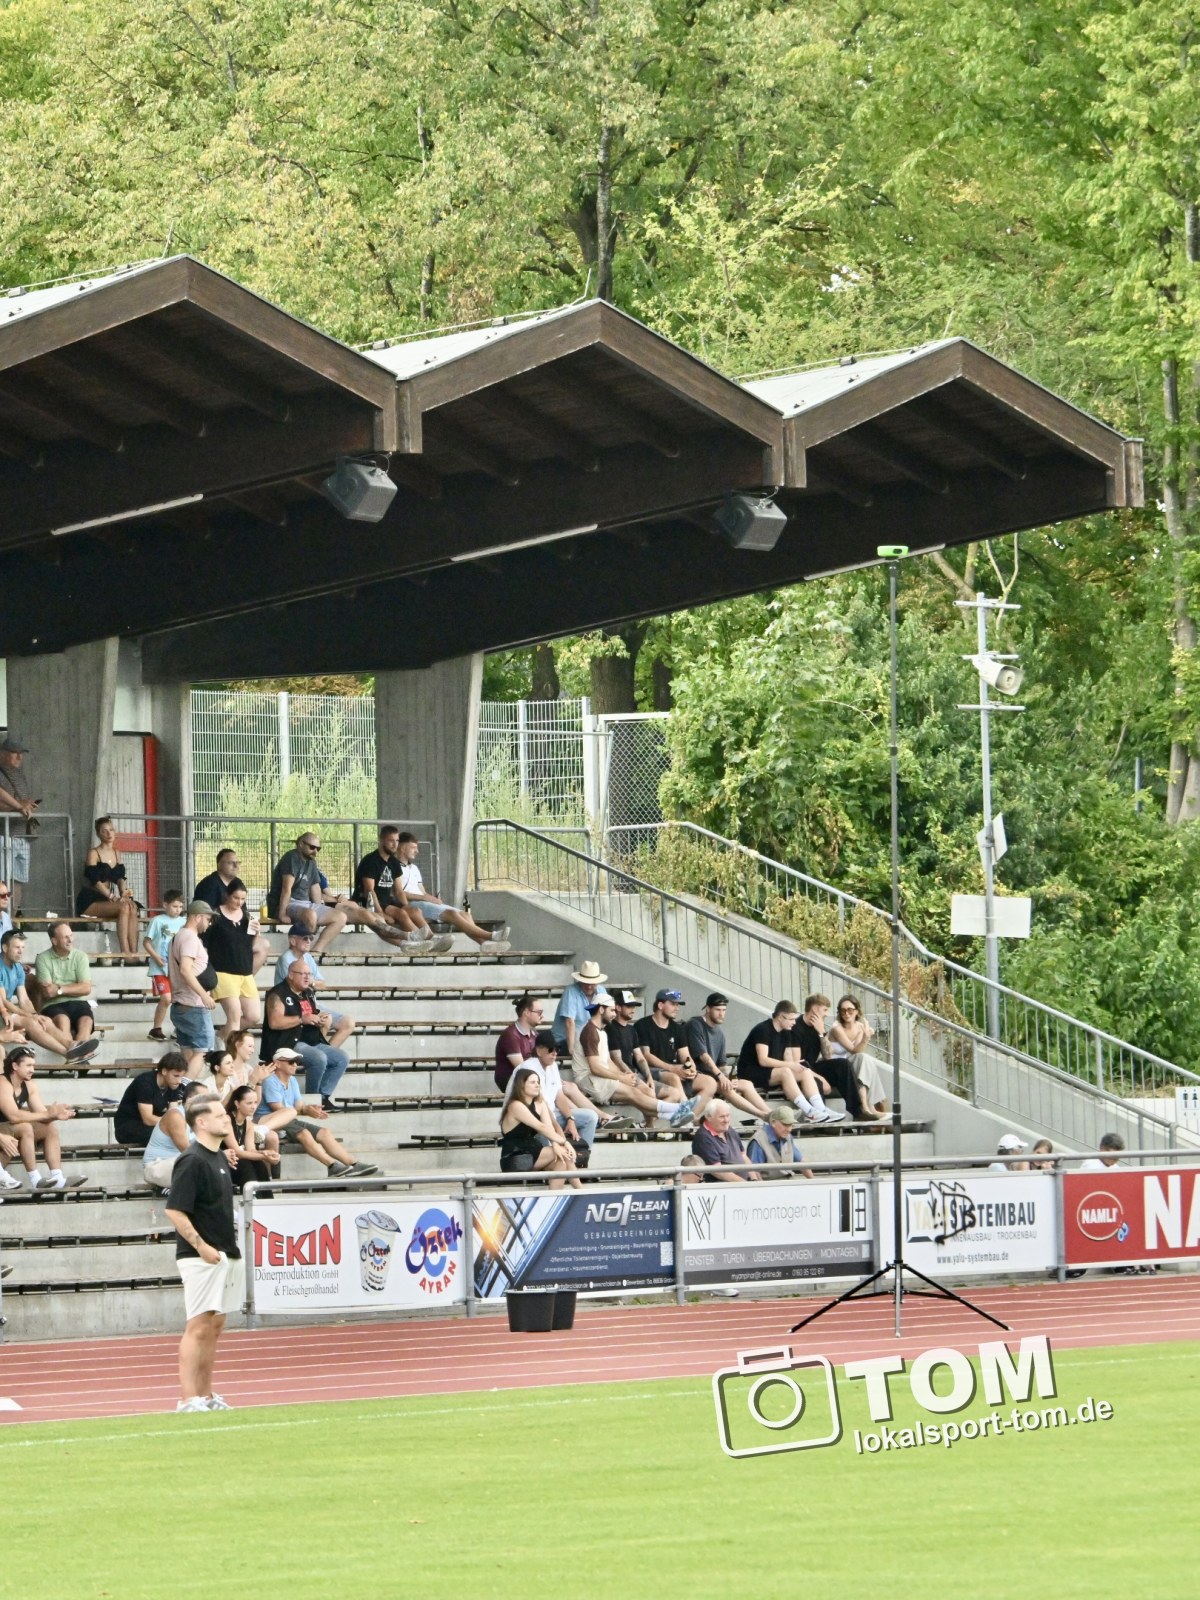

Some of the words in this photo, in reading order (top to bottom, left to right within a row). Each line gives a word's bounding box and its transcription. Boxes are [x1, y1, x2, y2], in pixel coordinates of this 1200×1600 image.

[752, 1205, 808, 1223] montagen
[252, 1214, 341, 1267] TEKIN
[685, 1254, 714, 1266] FENSTER
[722, 1252, 745, 1263] TÜREN
[753, 1249, 813, 1262] ÜBERDACHUNGEN
[820, 1247, 859, 1258] MONTAGEN
[255, 1267, 320, 1283] Dönerproduktion
[321, 1270, 339, 1279] GmbH
[419, 1260, 457, 1293] AYRAN
[274, 1286, 280, 1296] &
[282, 1284, 339, 1297] Fleischgroßhandel
